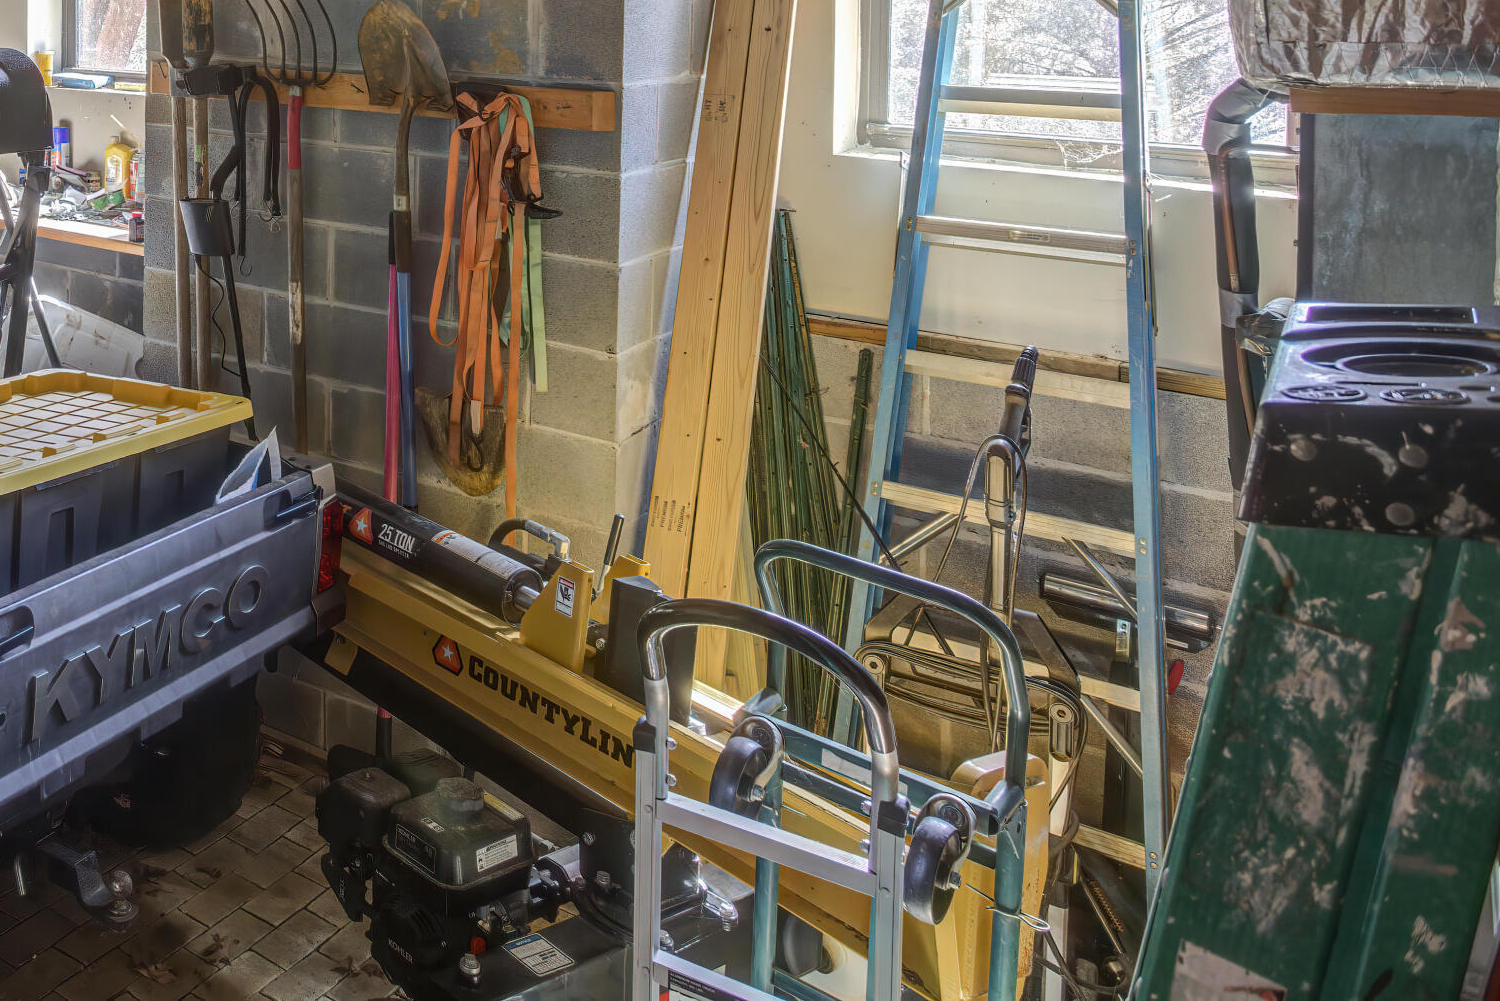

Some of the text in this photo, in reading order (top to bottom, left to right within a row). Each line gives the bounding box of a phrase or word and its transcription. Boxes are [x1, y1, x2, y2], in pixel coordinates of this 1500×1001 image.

[378, 523, 394, 542] 25
[395, 529, 415, 553] TON
[31, 565, 269, 741] KYMCO
[387, 936, 414, 965] KOHLER
